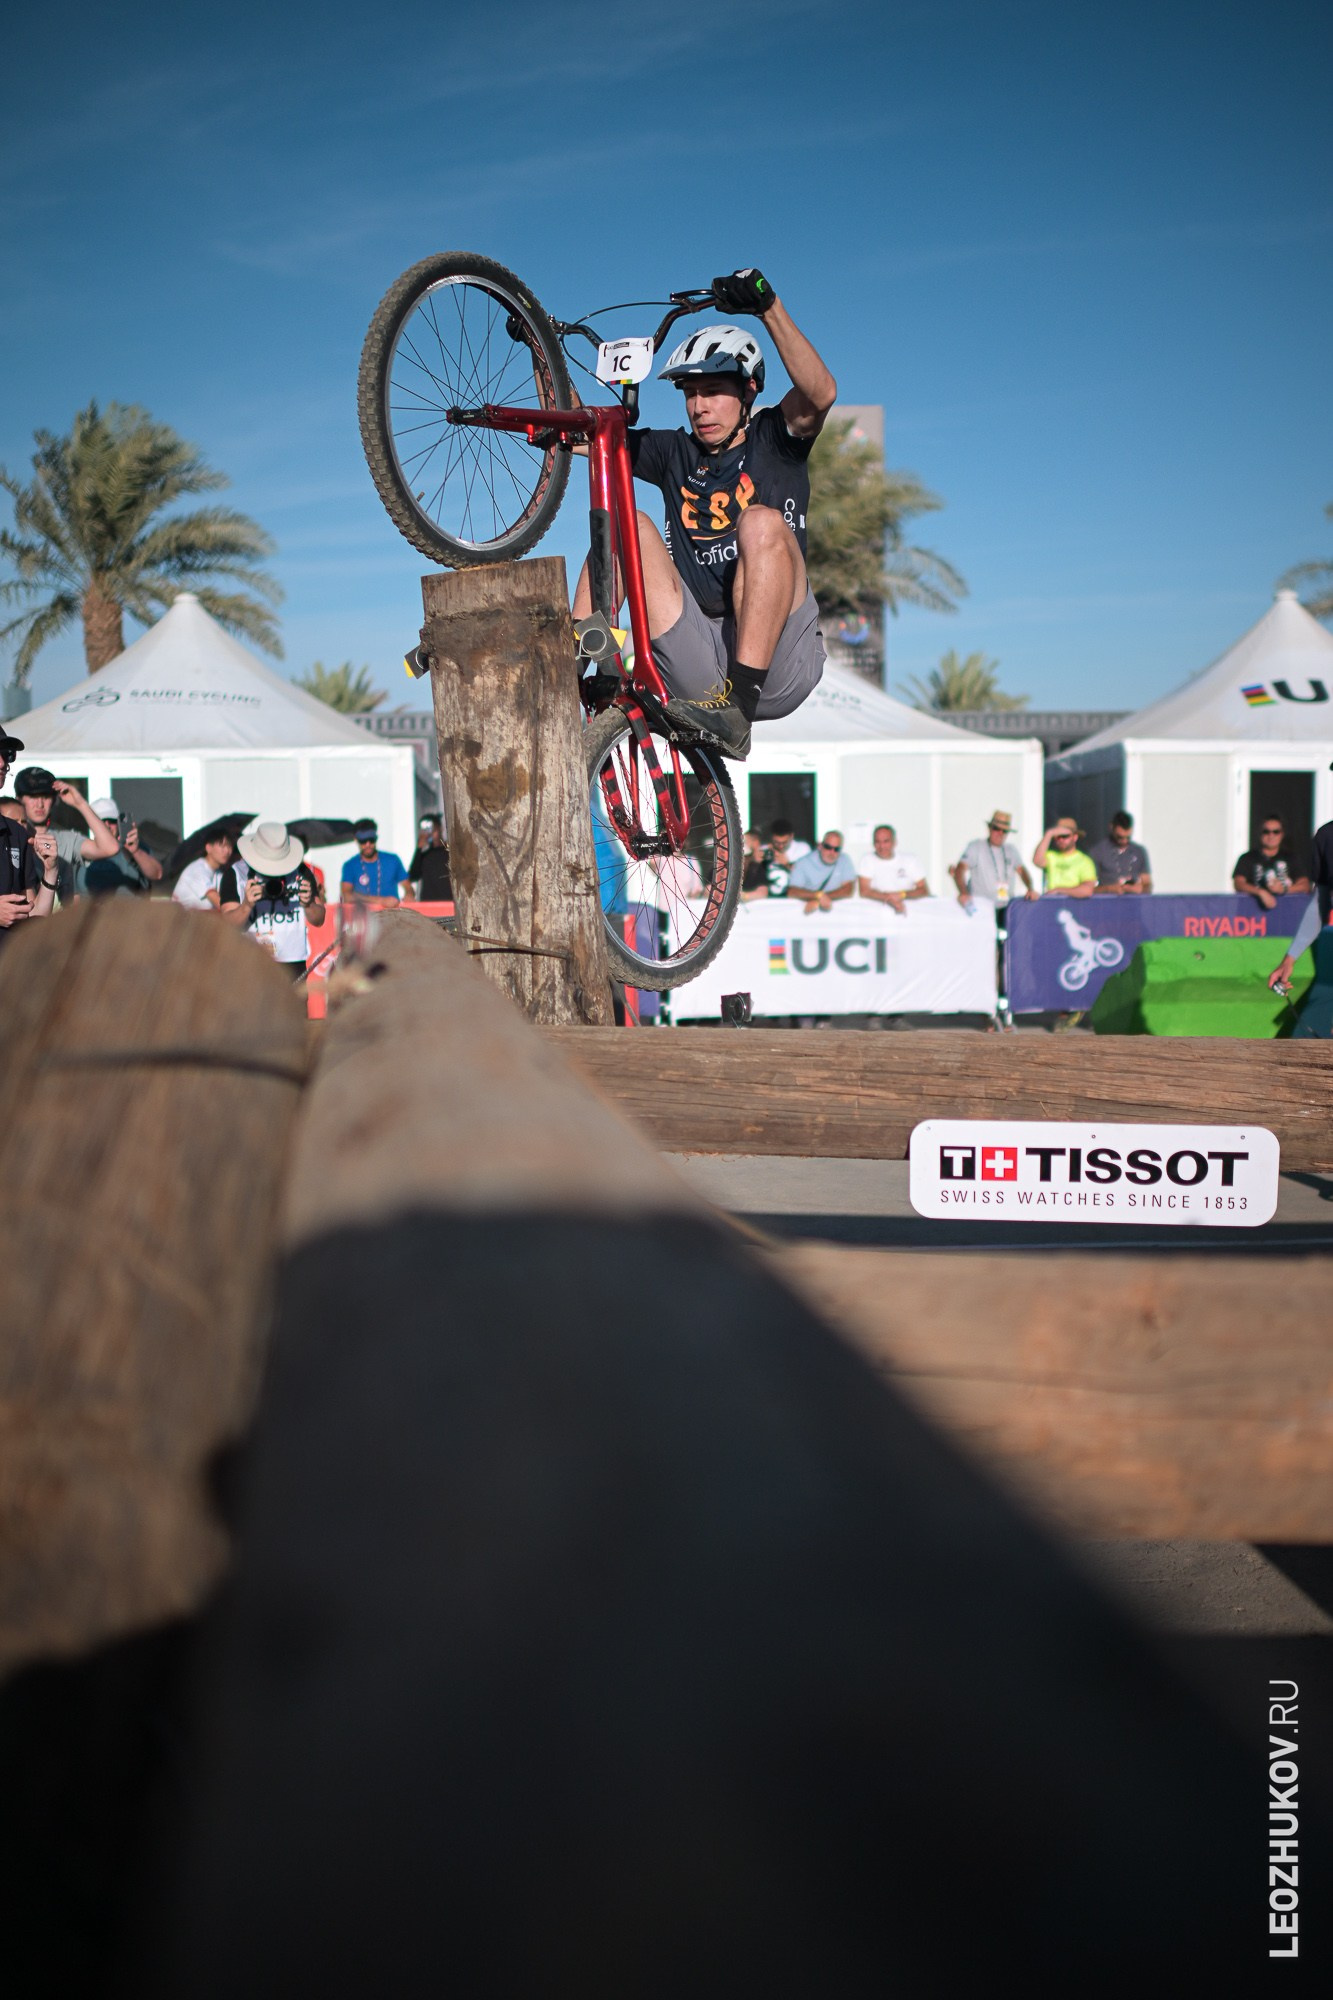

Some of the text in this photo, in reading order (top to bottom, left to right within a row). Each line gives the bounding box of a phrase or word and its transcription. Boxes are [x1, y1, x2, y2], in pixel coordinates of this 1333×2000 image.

[612, 354, 632, 373] 1C
[783, 498, 796, 532] Cof
[1184, 916, 1267, 938] RIYADH
[791, 938, 887, 975] UCI
[1025, 1147, 1250, 1187] TISSOT
[940, 1190, 1249, 1210] SWISS WATCHES SINCE 1853
